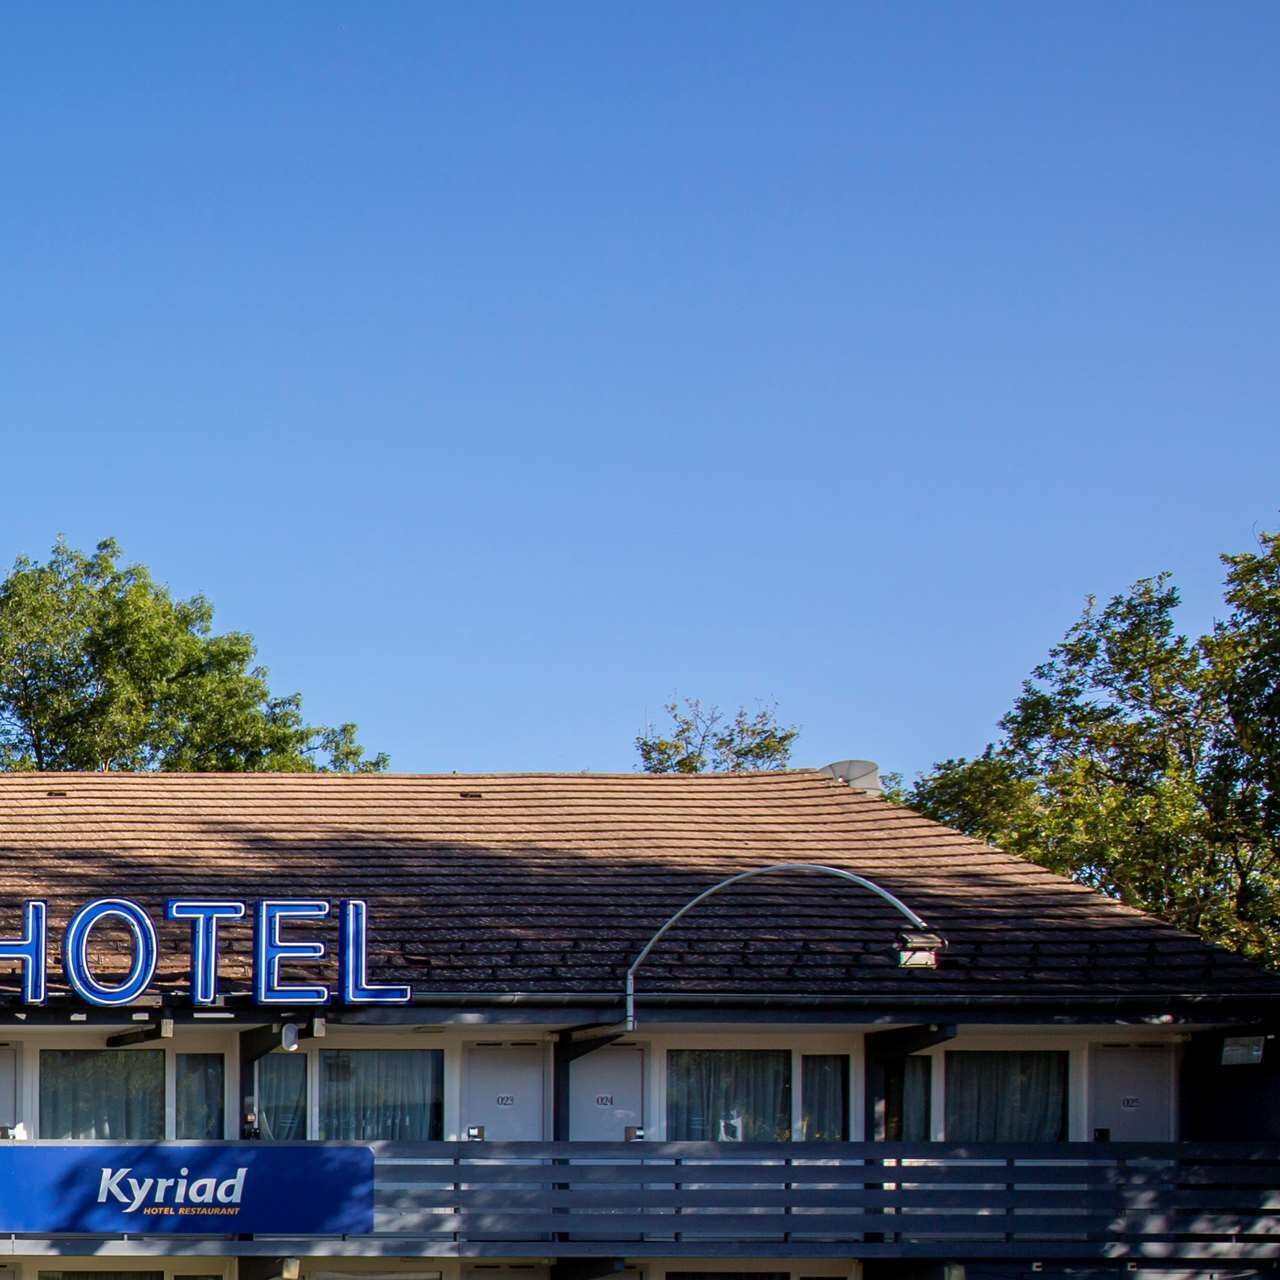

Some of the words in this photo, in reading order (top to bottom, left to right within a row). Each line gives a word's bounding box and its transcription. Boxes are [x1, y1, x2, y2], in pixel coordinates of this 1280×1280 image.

[497, 1096, 514, 1106] 023
[597, 1096, 614, 1106] 024
[97, 1167, 248, 1213] Kyriad
[143, 1207, 175, 1215] HOTEL
[178, 1207, 241, 1216] RESTAURANT
